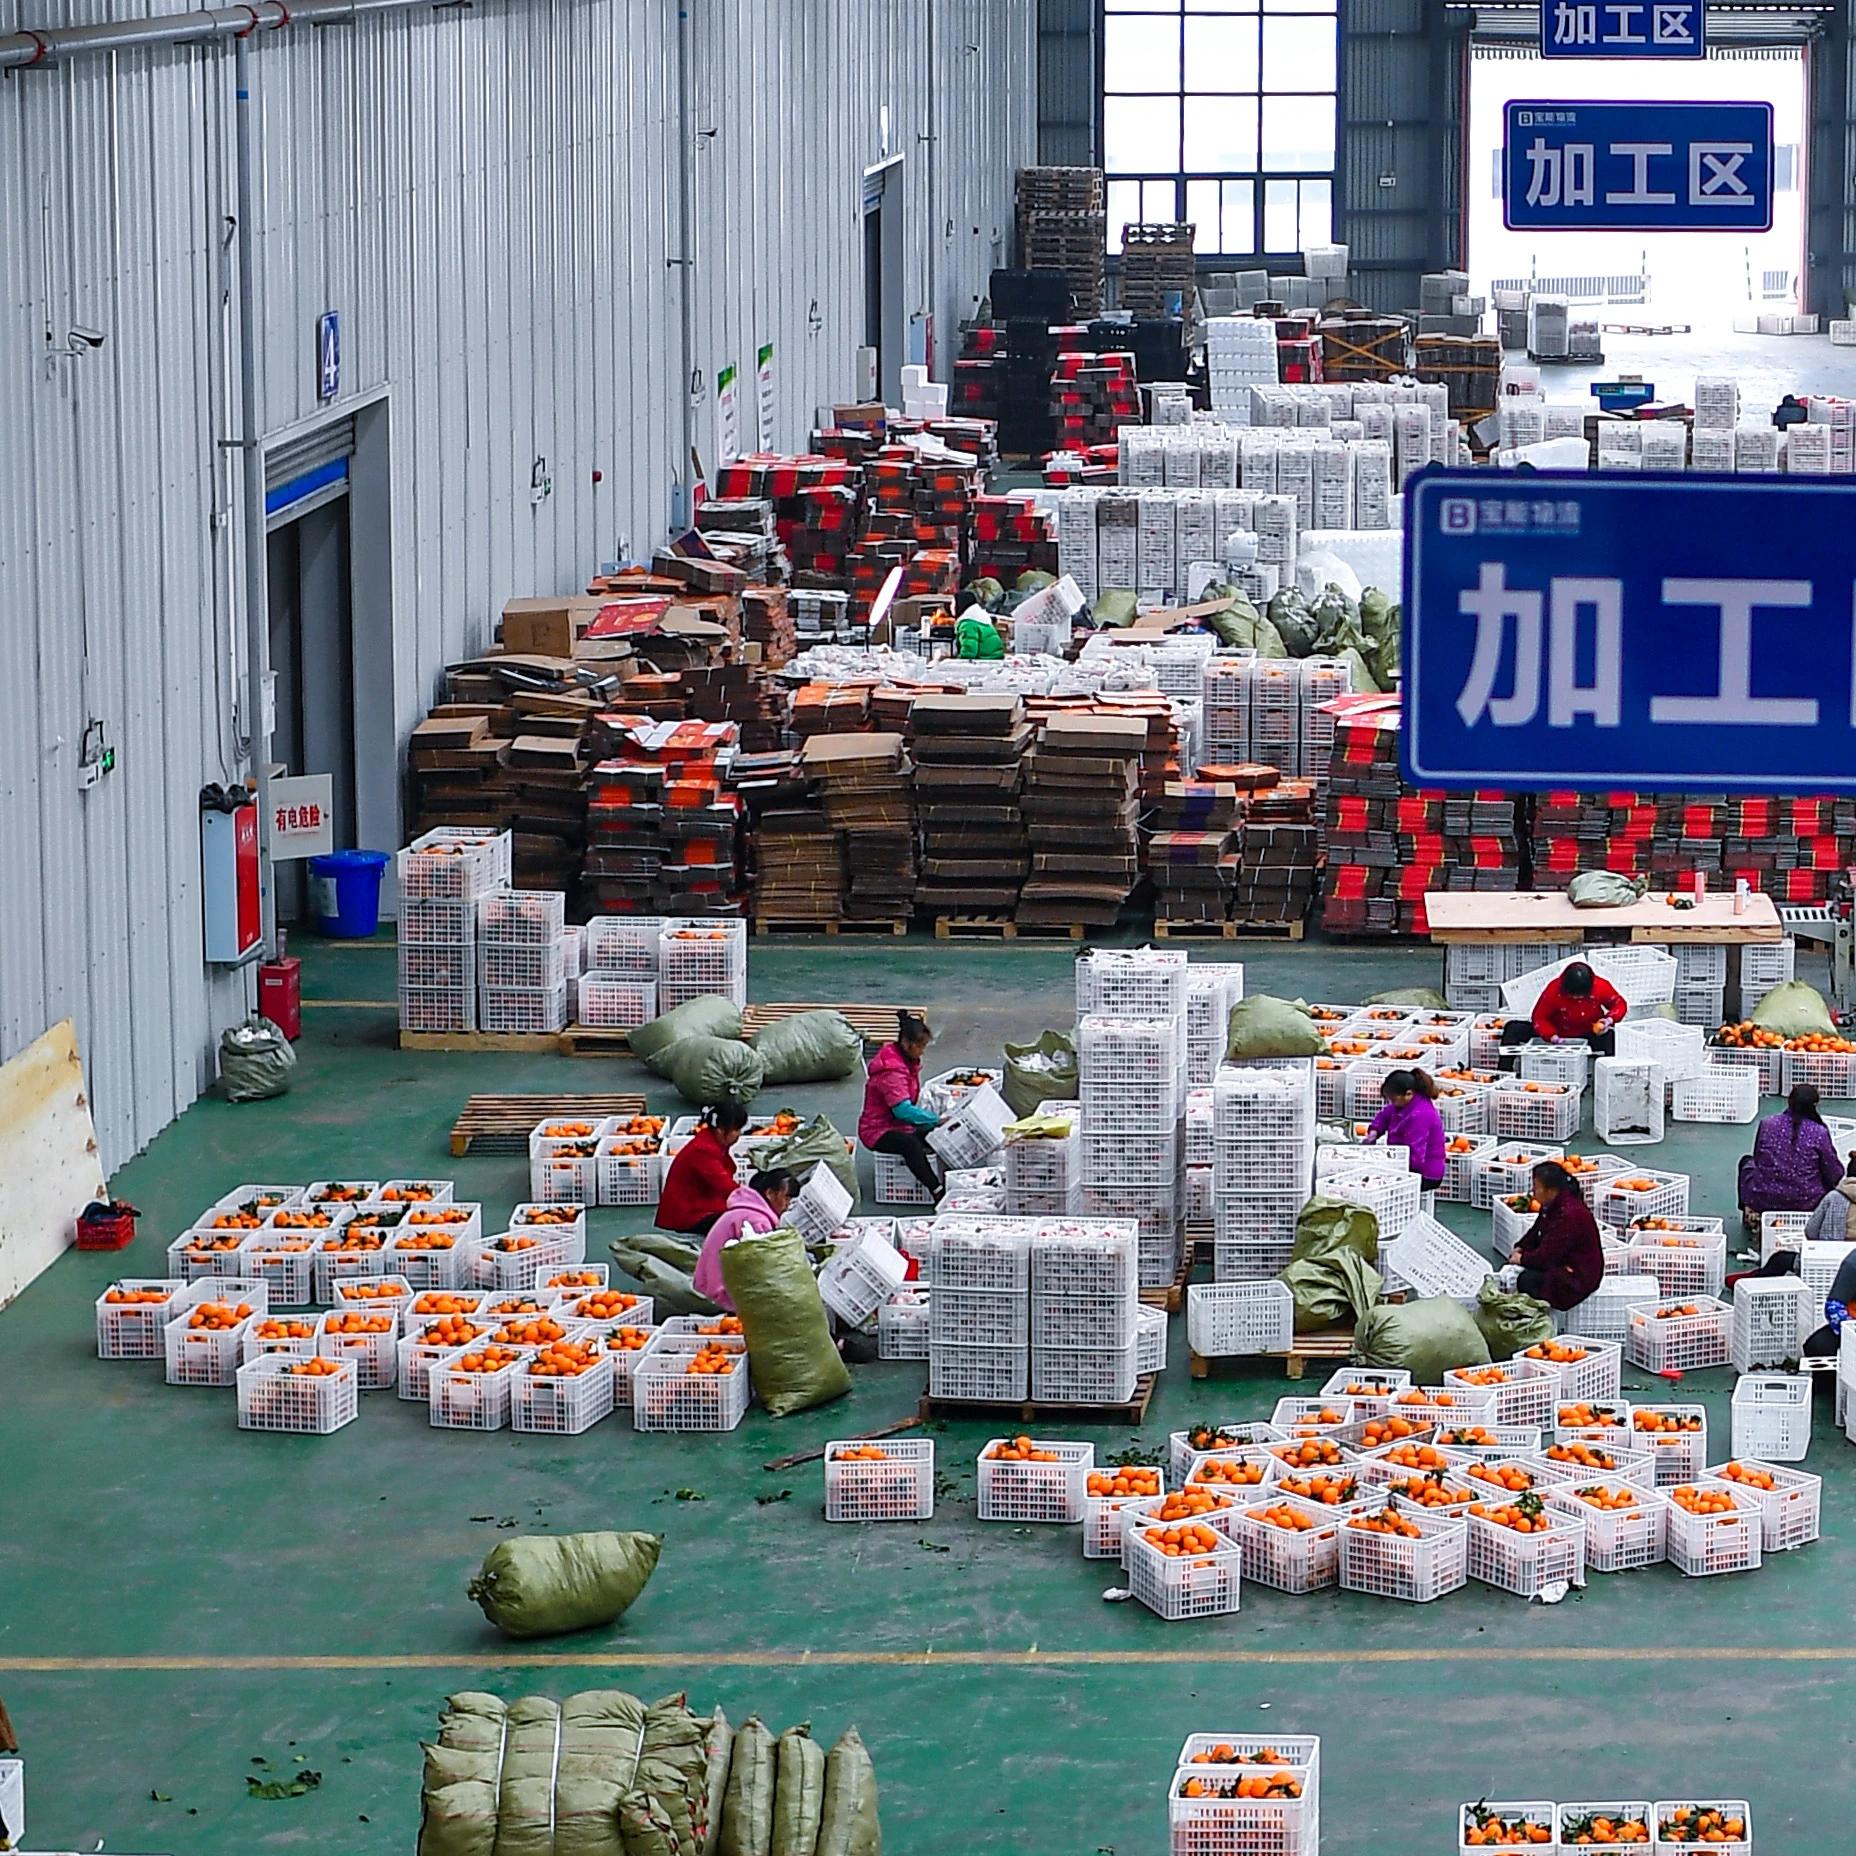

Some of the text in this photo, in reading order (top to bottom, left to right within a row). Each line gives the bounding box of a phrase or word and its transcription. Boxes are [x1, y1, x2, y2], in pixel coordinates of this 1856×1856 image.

[1554, 2, 1694, 44] 加工区
[1526, 137, 1755, 207] 加工区
[325, 328, 337, 387] 4
[275, 804, 320, 832] 有电危险
